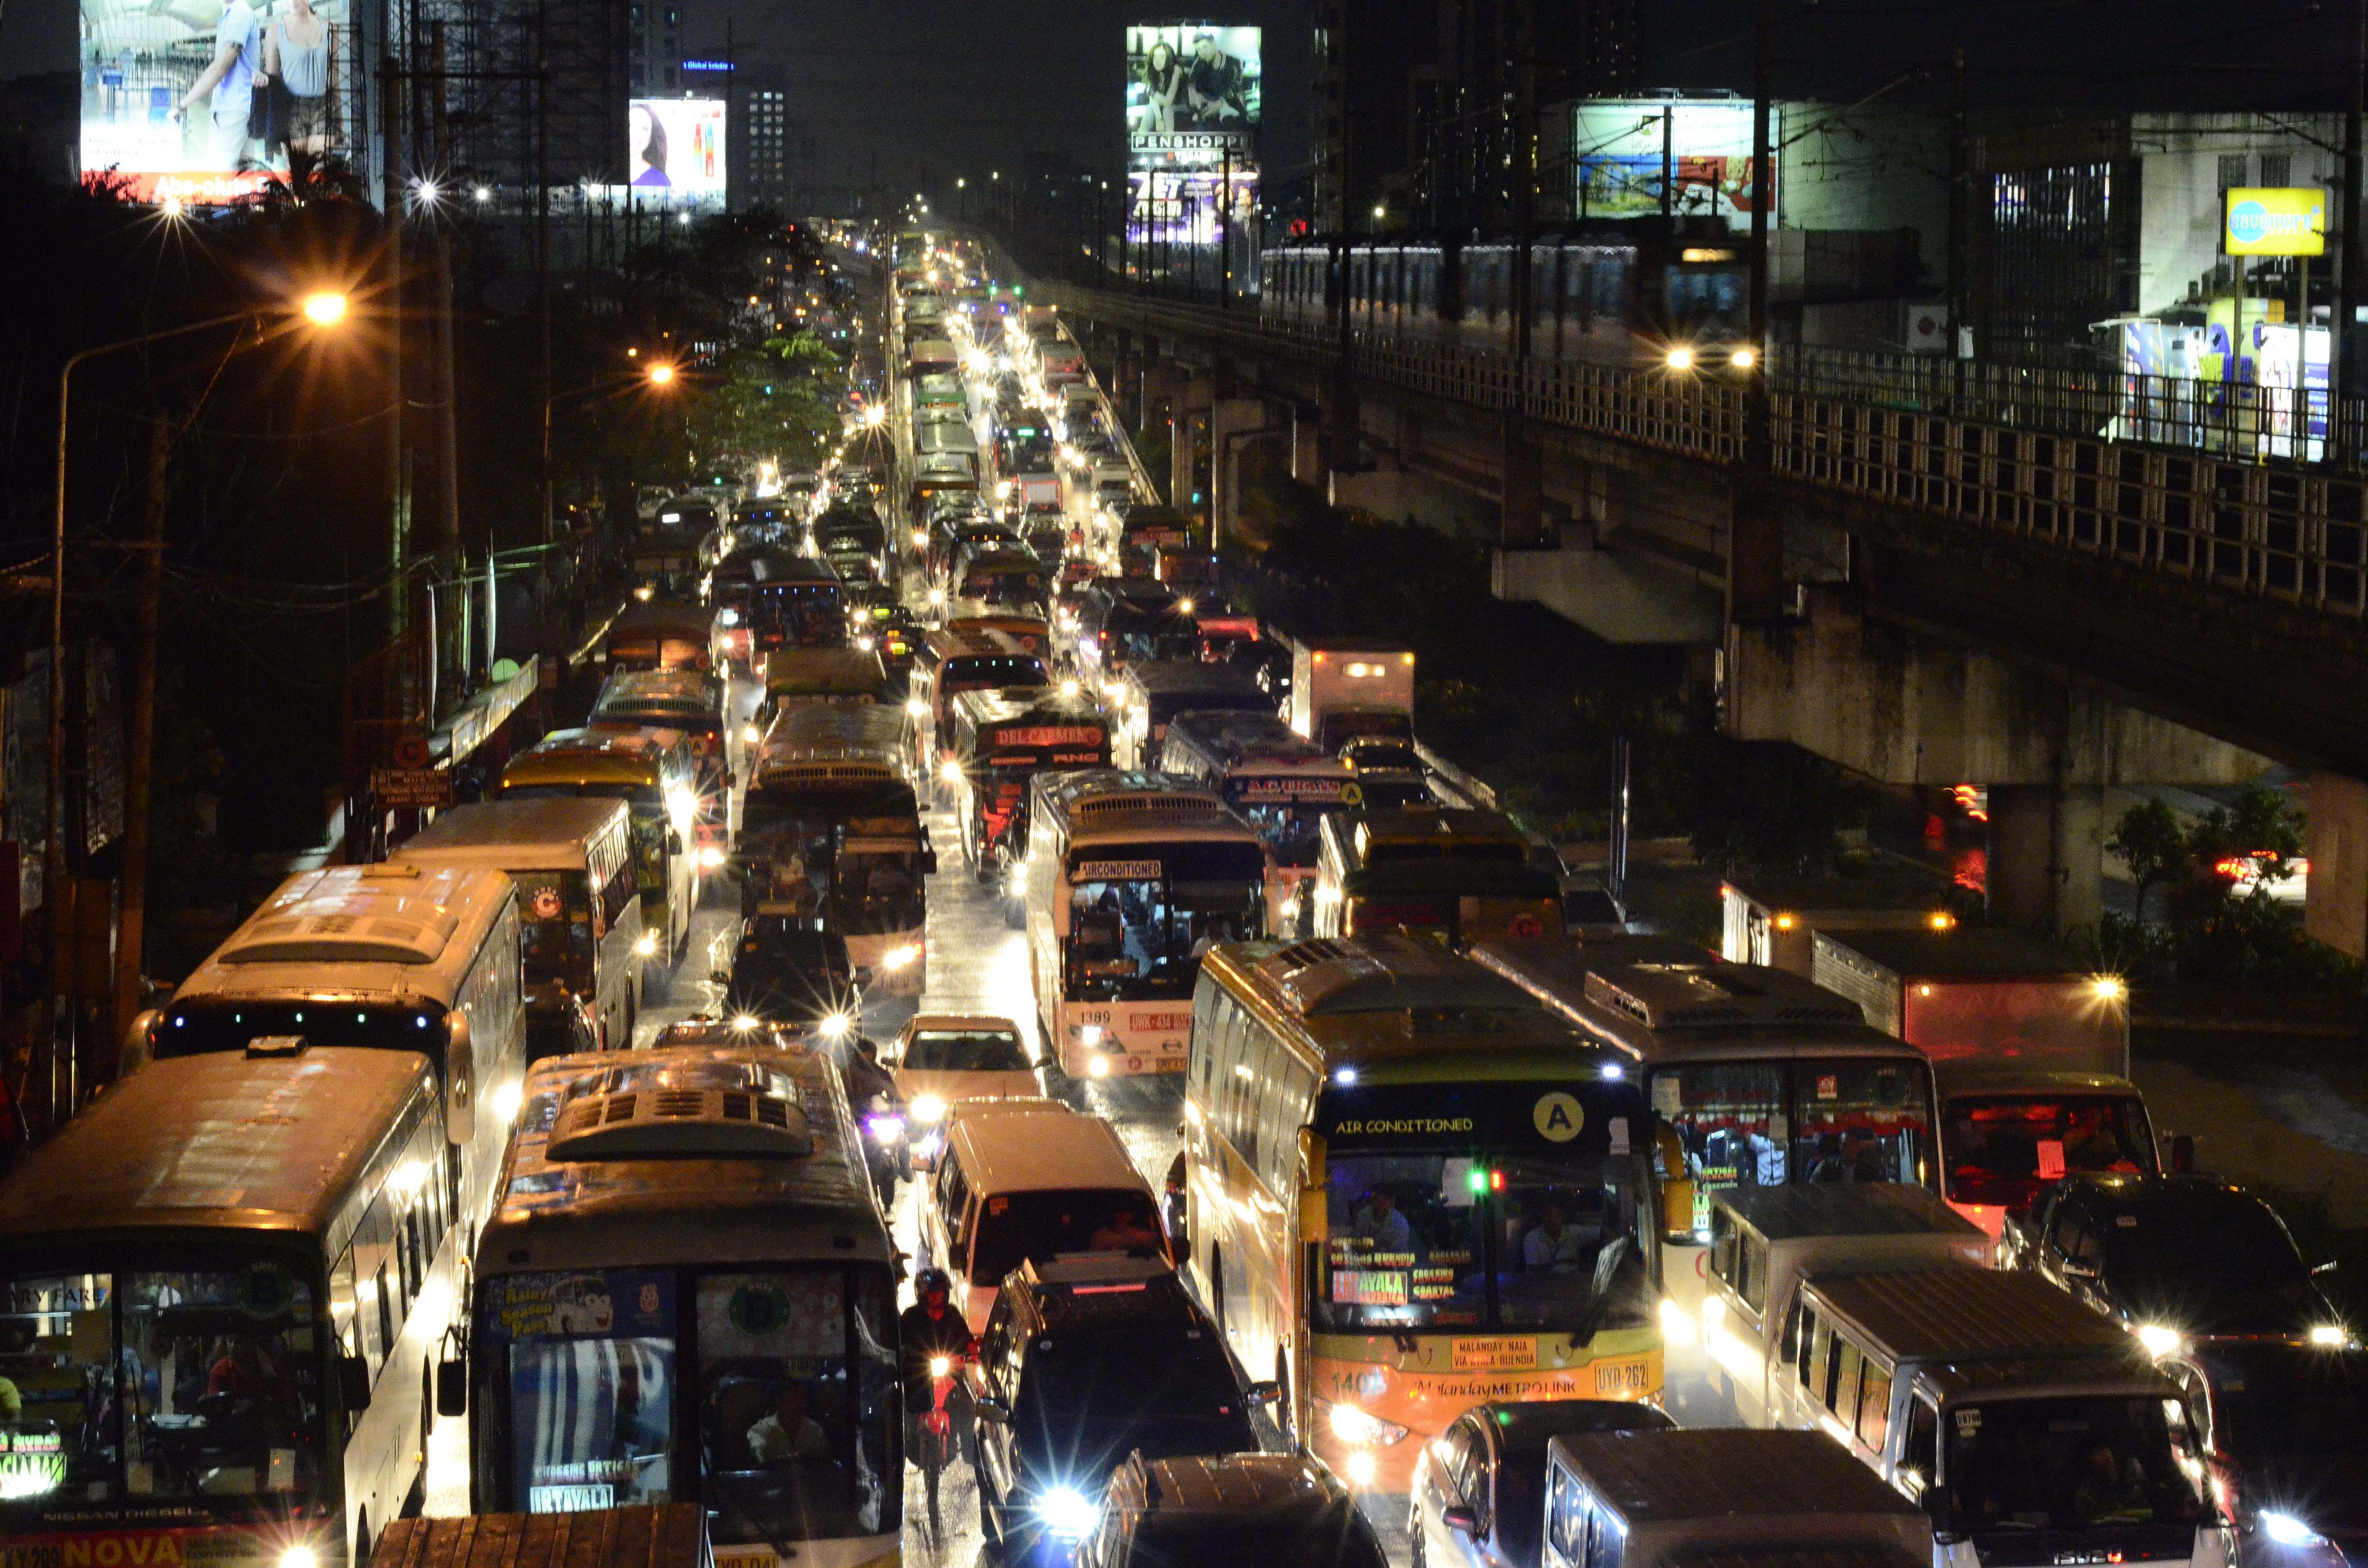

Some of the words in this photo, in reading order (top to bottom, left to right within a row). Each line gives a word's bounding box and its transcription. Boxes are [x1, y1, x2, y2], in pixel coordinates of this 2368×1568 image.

[1082, 1011, 1110, 1024] 1389
[1547, 1103, 1572, 1130] A
[1335, 1121, 1363, 1134] AIR
[1366, 1118, 1473, 1134] CONDITIONED
[1359, 1272, 1404, 1293] AYALA
[1459, 1341, 1503, 1352] MALANDAY
[1509, 1341, 1528, 1352] NAIA
[1455, 1356, 1467, 1366] VIA
[1500, 1354, 1534, 1366] BUENDIA
[43, 1510, 119, 1523] NISSAN
[63, 1536, 183, 1567] NOVA
